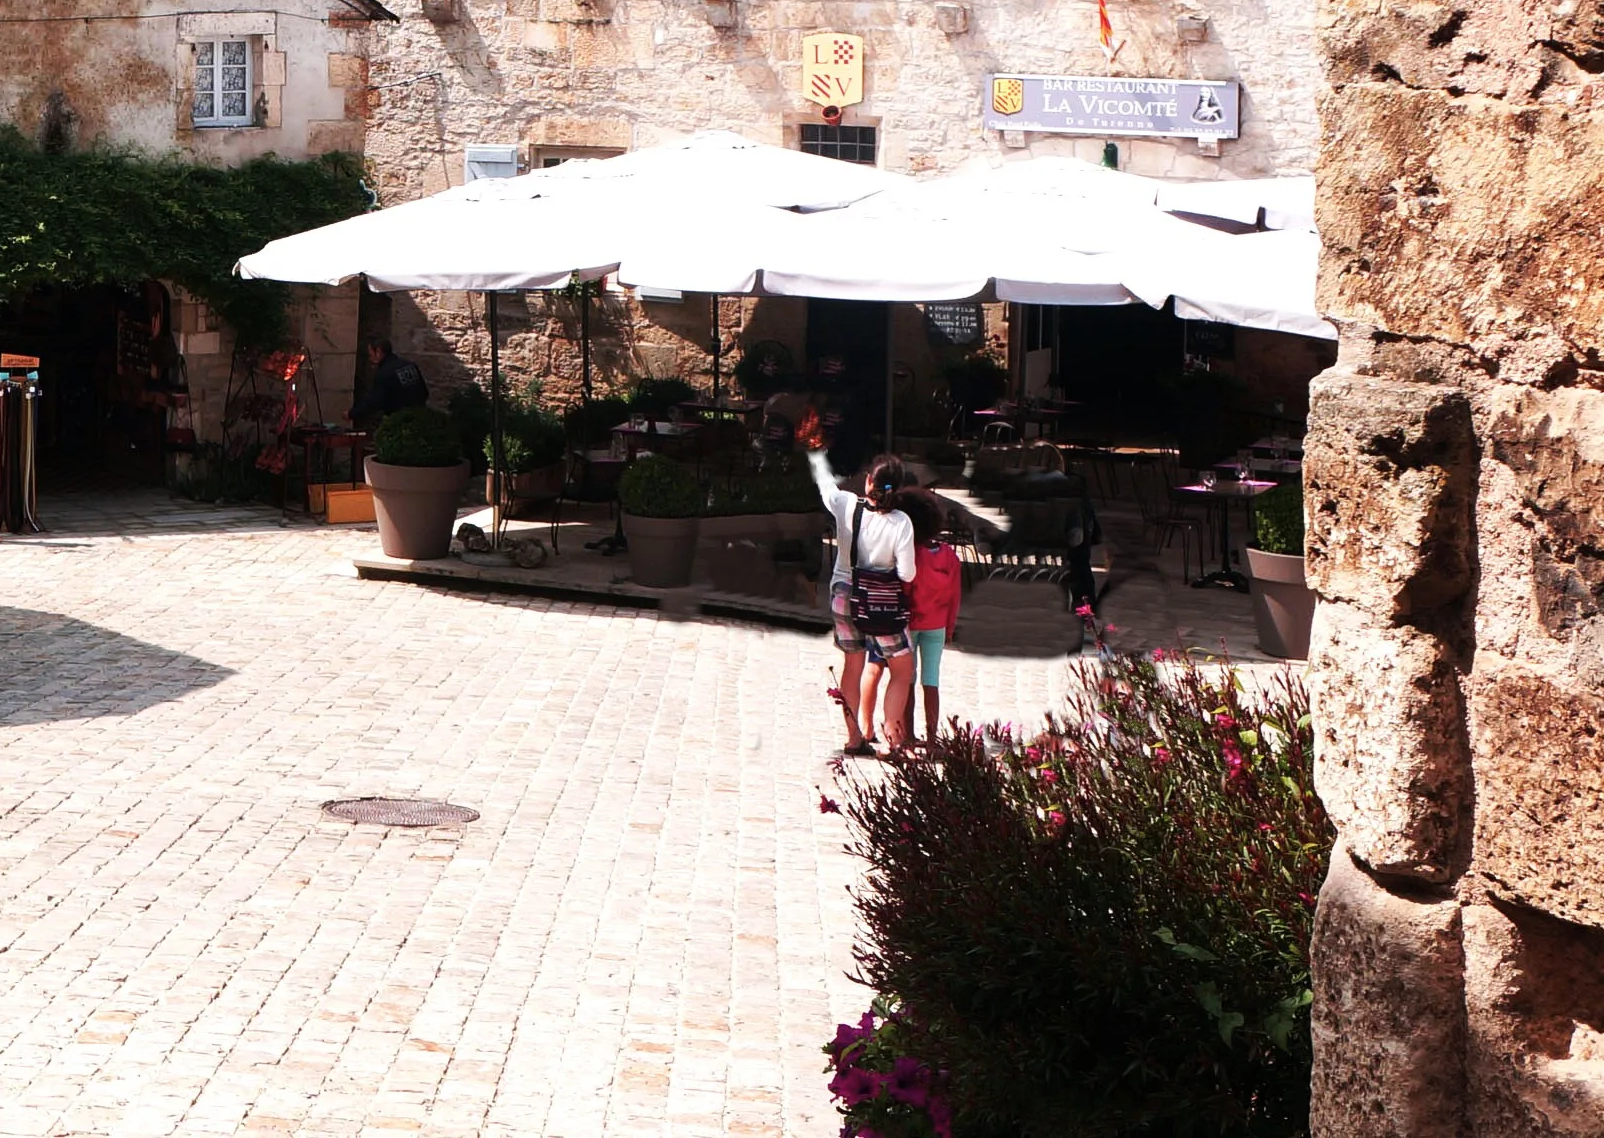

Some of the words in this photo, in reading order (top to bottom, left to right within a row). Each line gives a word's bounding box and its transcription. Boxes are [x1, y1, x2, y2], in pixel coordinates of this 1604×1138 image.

[814, 44, 829, 65] L
[835, 77, 853, 98] V
[1043, 79, 1074, 92] BAR
[1076, 80, 1180, 95] RESTAURANT
